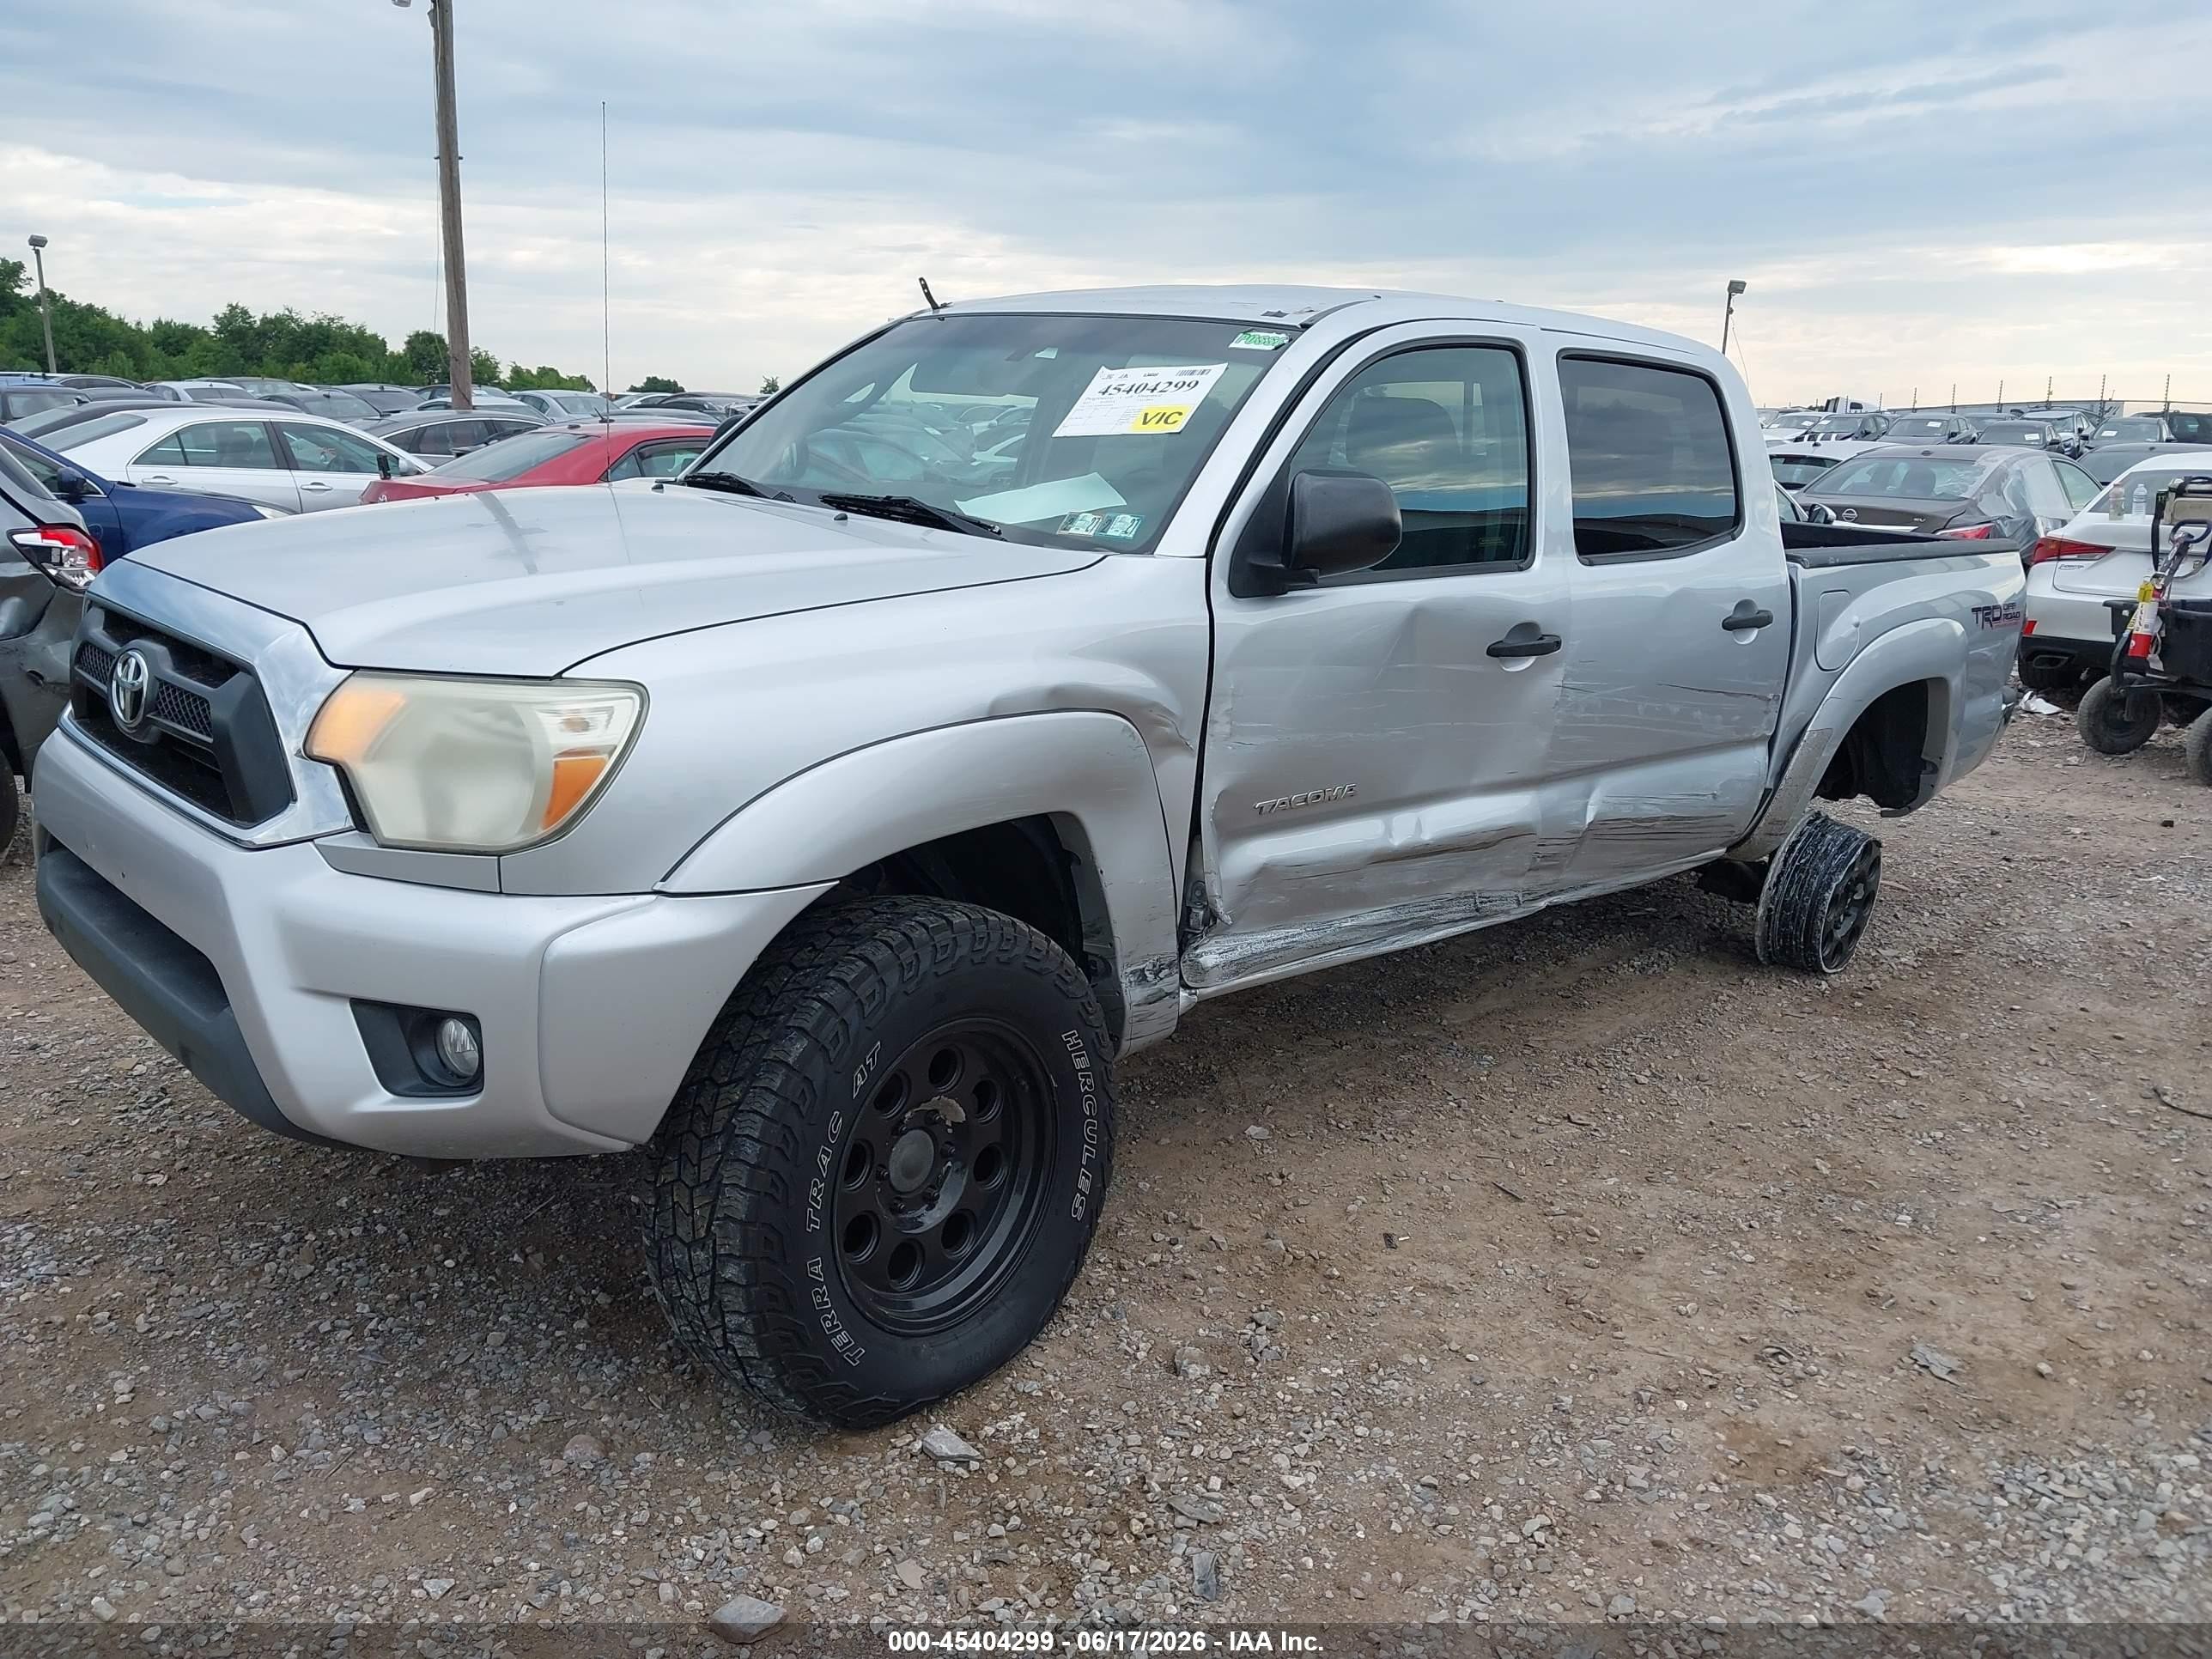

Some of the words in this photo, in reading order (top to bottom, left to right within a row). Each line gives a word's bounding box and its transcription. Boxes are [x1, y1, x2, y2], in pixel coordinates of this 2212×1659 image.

[1097, 380, 1200, 396] 45404299
[1141, 411, 1183, 426] VIC
[1971, 604, 2002, 630] TRD
[1253, 782, 1357, 816] TACOMA
[852, 1040, 881, 1100] AT
[1061, 1030, 1098, 1222] HERCULES
[805, 1110, 842, 1233] TRAC
[806, 1256, 866, 1367] TERRA
